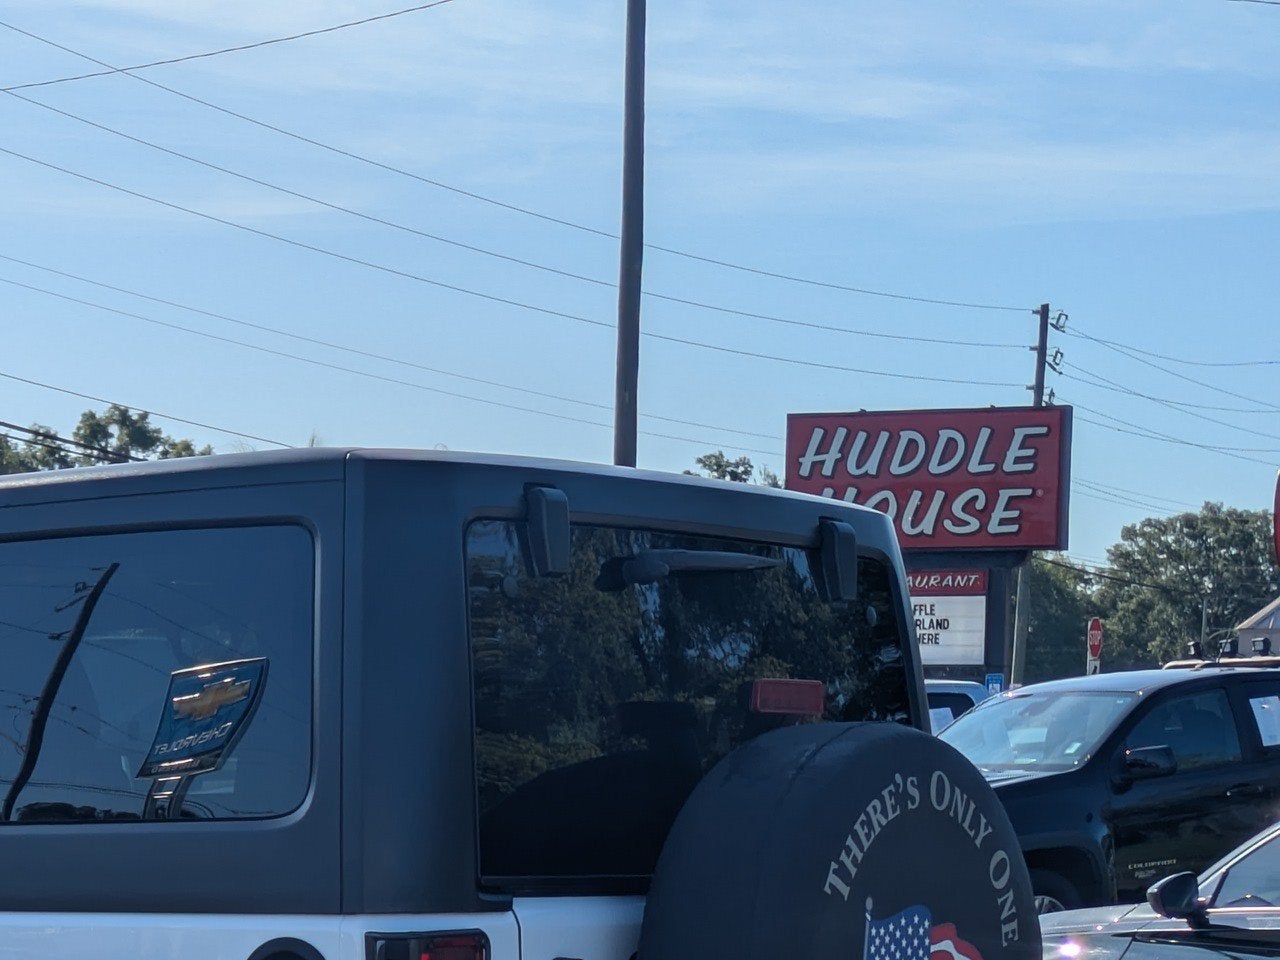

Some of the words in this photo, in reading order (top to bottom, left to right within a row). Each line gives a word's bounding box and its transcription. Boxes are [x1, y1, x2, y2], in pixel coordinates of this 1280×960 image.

[798, 426, 1049, 477] HUDDLE
[915, 618, 950, 630] RLAND
[1089, 630, 1101, 645] STOP
[824, 772, 920, 902] THERE'S
[930, 770, 994, 850] ONLY
[989, 849, 1019, 947] ONE
